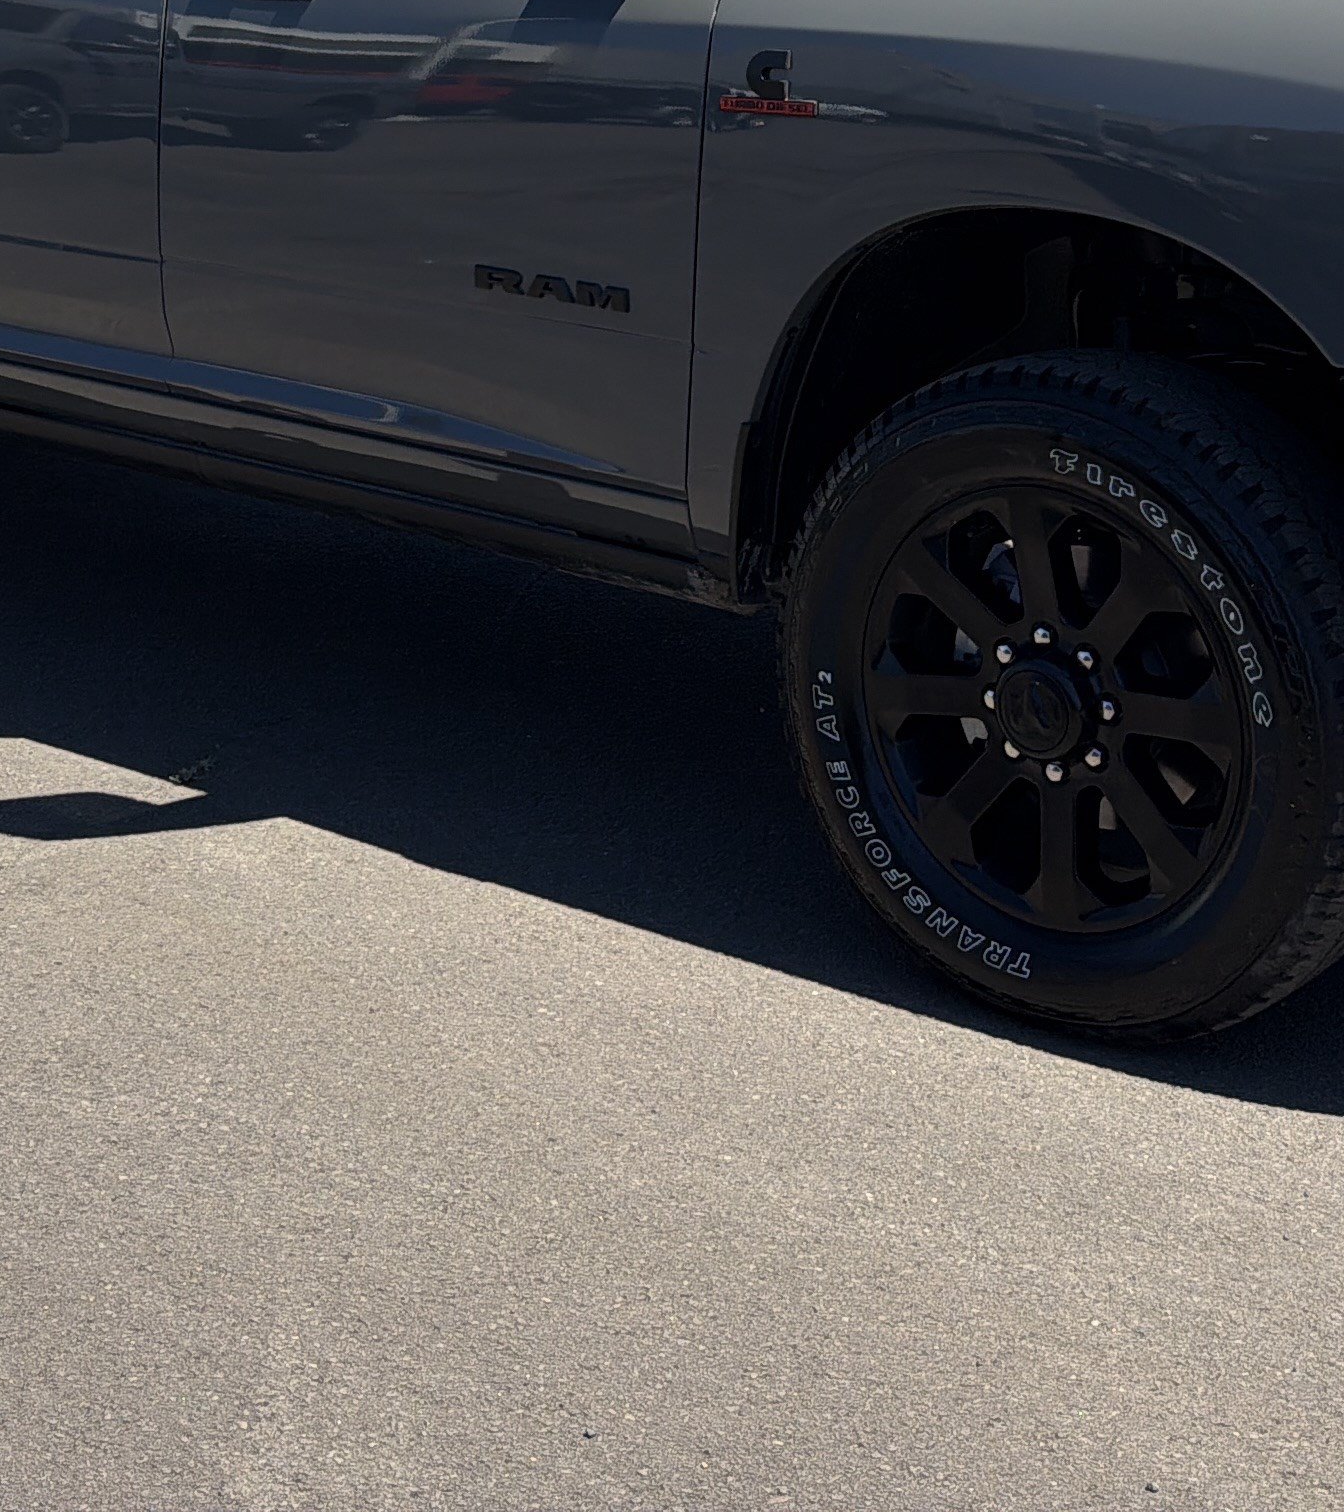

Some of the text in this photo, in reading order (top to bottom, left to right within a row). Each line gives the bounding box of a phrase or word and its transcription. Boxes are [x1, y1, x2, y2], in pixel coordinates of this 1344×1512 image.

[474, 264, 631, 314] RAM
[1049, 448, 1274, 728] Firestone
[831, 761, 1033, 980] TRANSFORCE
